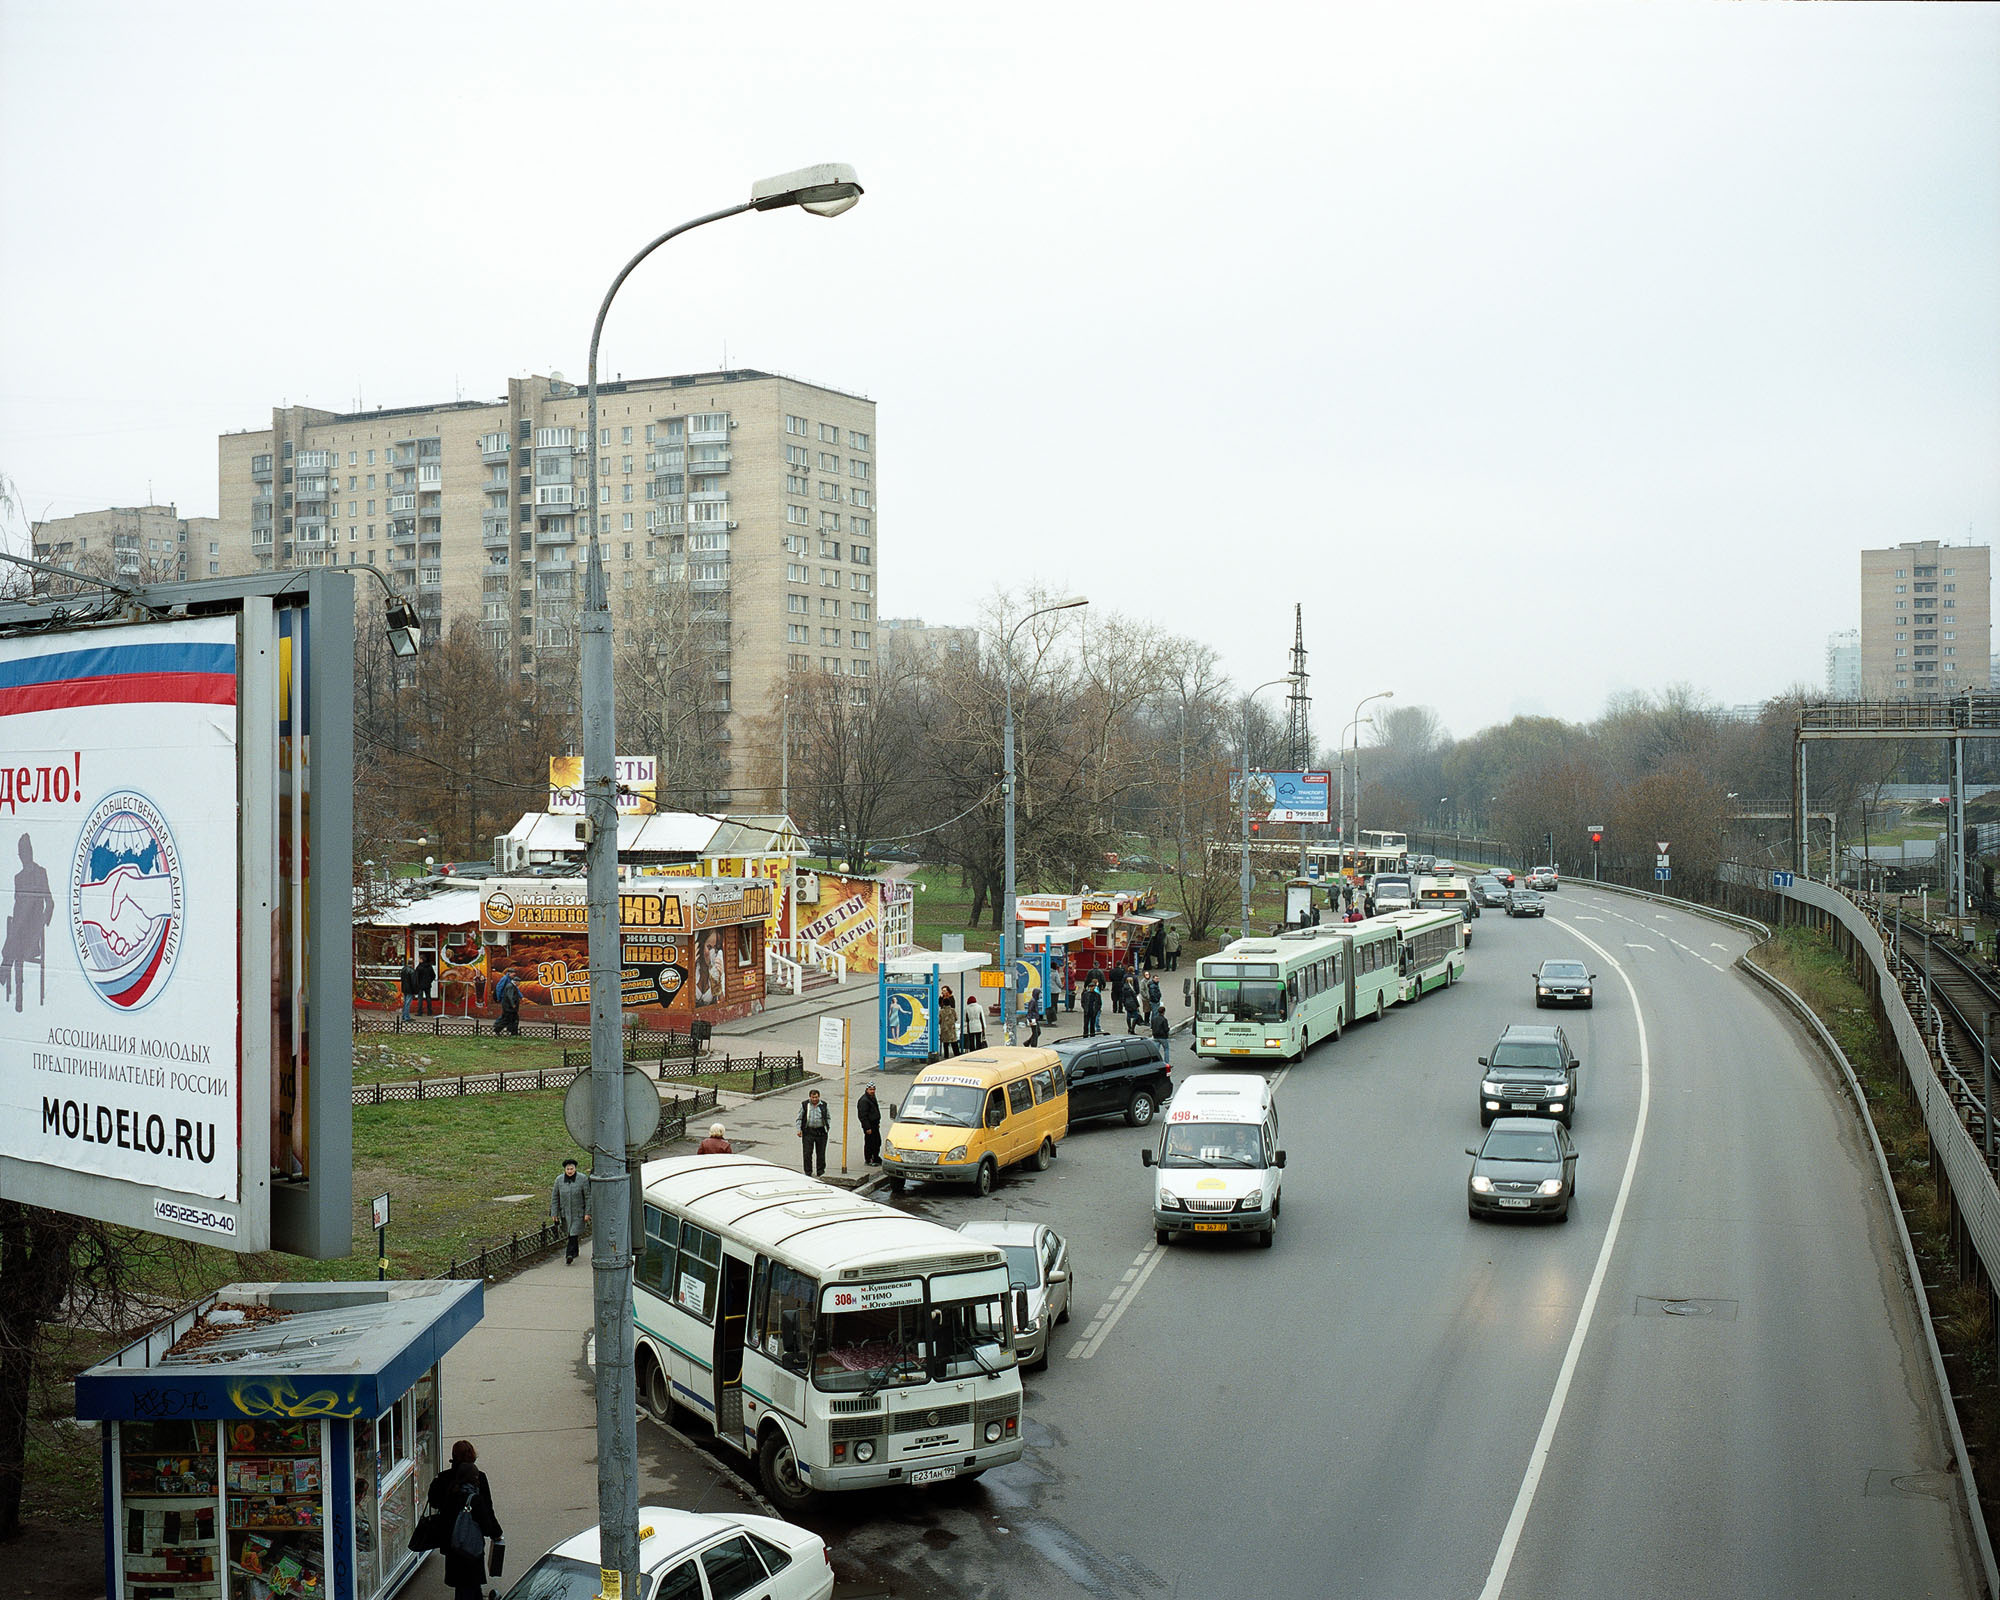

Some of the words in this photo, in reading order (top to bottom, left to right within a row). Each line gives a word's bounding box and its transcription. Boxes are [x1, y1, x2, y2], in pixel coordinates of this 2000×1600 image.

[615, 761, 654, 781] ЕТЫ
[0, 752, 81, 815] дело!
[73, 811, 102, 960] МЕЖРЕГИОНАЛЬНАЯ
[102, 796, 169, 845] ОБЩЕСТВЕННАЯ
[163, 844, 182, 966] ОРГАНИЗАЦИЯ
[522, 895, 586, 906] магази
[800, 896, 865, 940] ЦВЕТЫ
[626, 934, 675, 943] живое
[625, 945, 676, 962] ПИВО
[540, 963, 566, 986] 30
[552, 985, 590, 1004] ПИВ
[47, 1027, 136, 1054] АССОЦИАЦИЯ
[140, 1039, 211, 1064] МОЛОДЫХ
[33, 1053, 165, 1088] ПРЕДПРИНИМАТЕЛЕЙ
[170, 1072, 229, 1098] РОССИИ
[923, 1074, 981, 1087] ПОПУТЧИК
[1171, 1110, 1191, 1121] 498
[42, 1096, 216, 1164] MOLDELO.RU
[154, 1201, 235, 1232] (495)225-20-40
[861, 1292, 893, 1302] МГИМО
